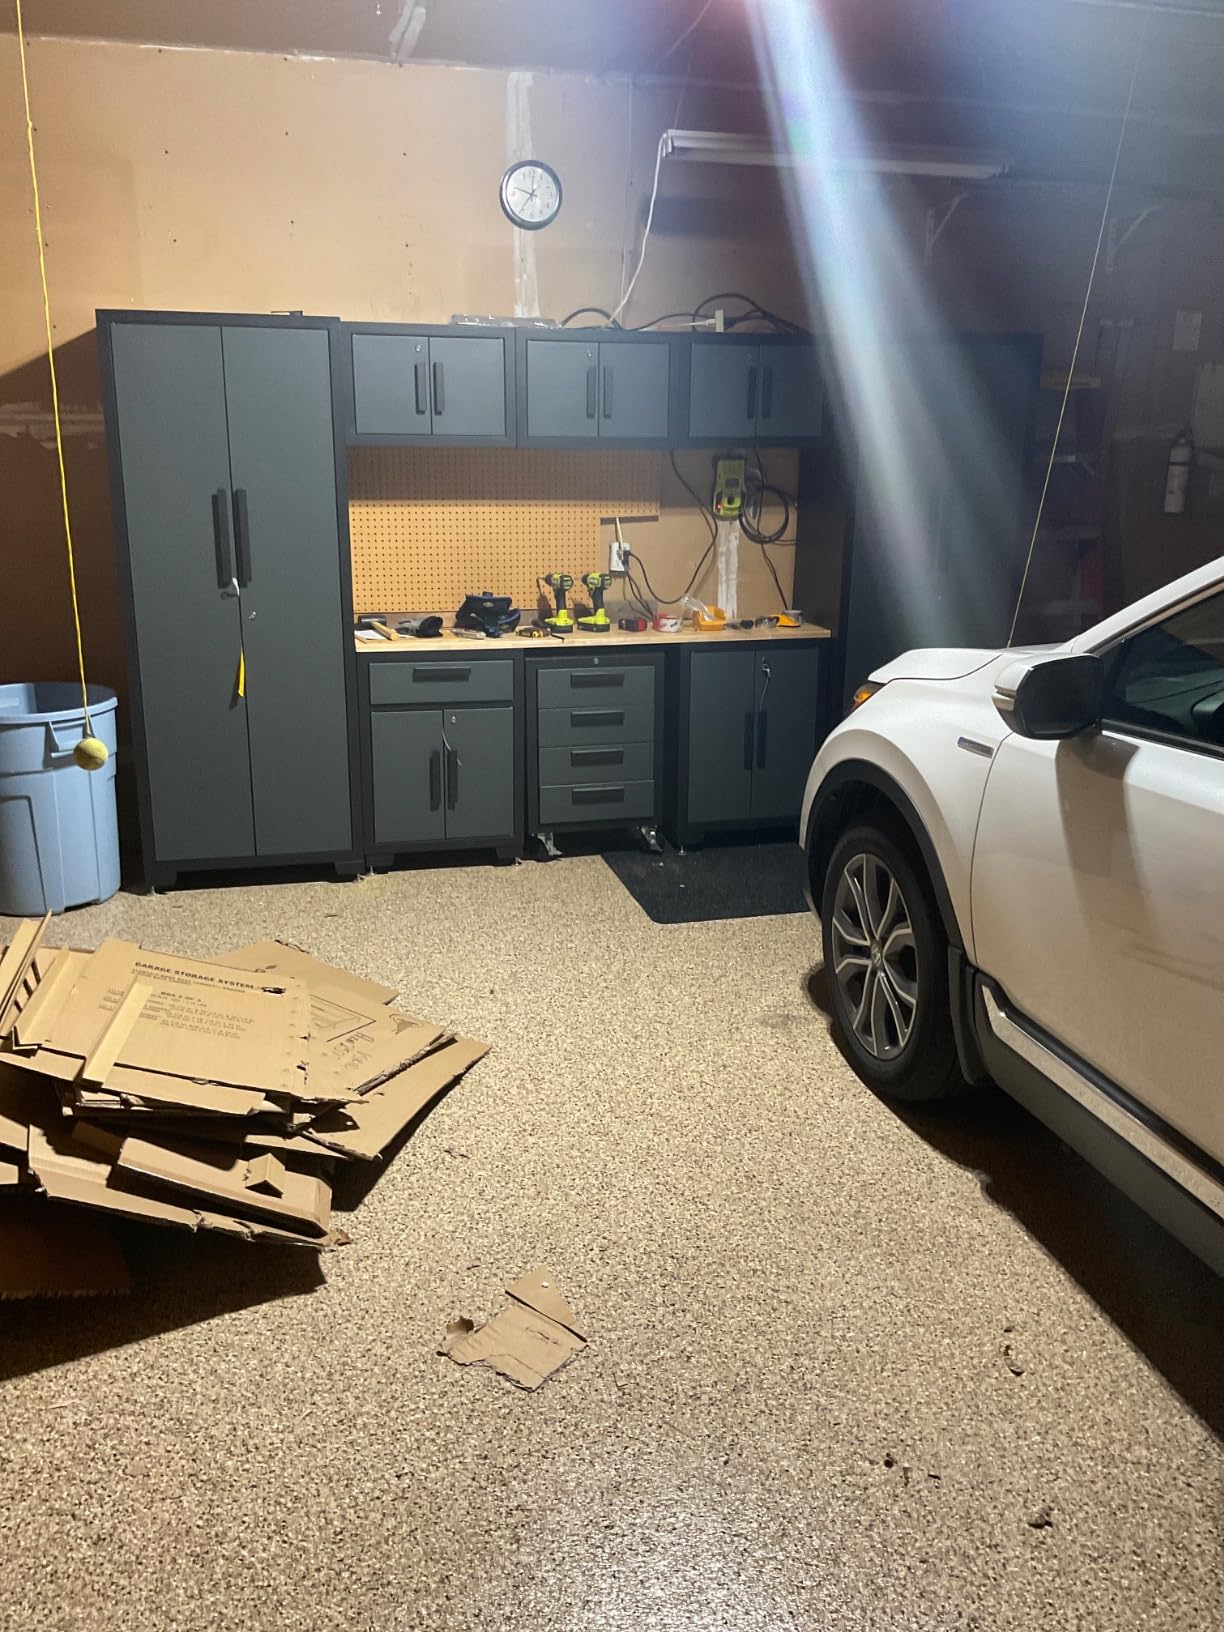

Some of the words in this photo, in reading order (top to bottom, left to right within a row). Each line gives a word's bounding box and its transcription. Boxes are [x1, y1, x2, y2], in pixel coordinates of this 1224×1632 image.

[135, 962, 171, 973] GARAGE
[174, 970, 216, 982] STORAGE
[217, 979, 254, 989] SYSTEM
